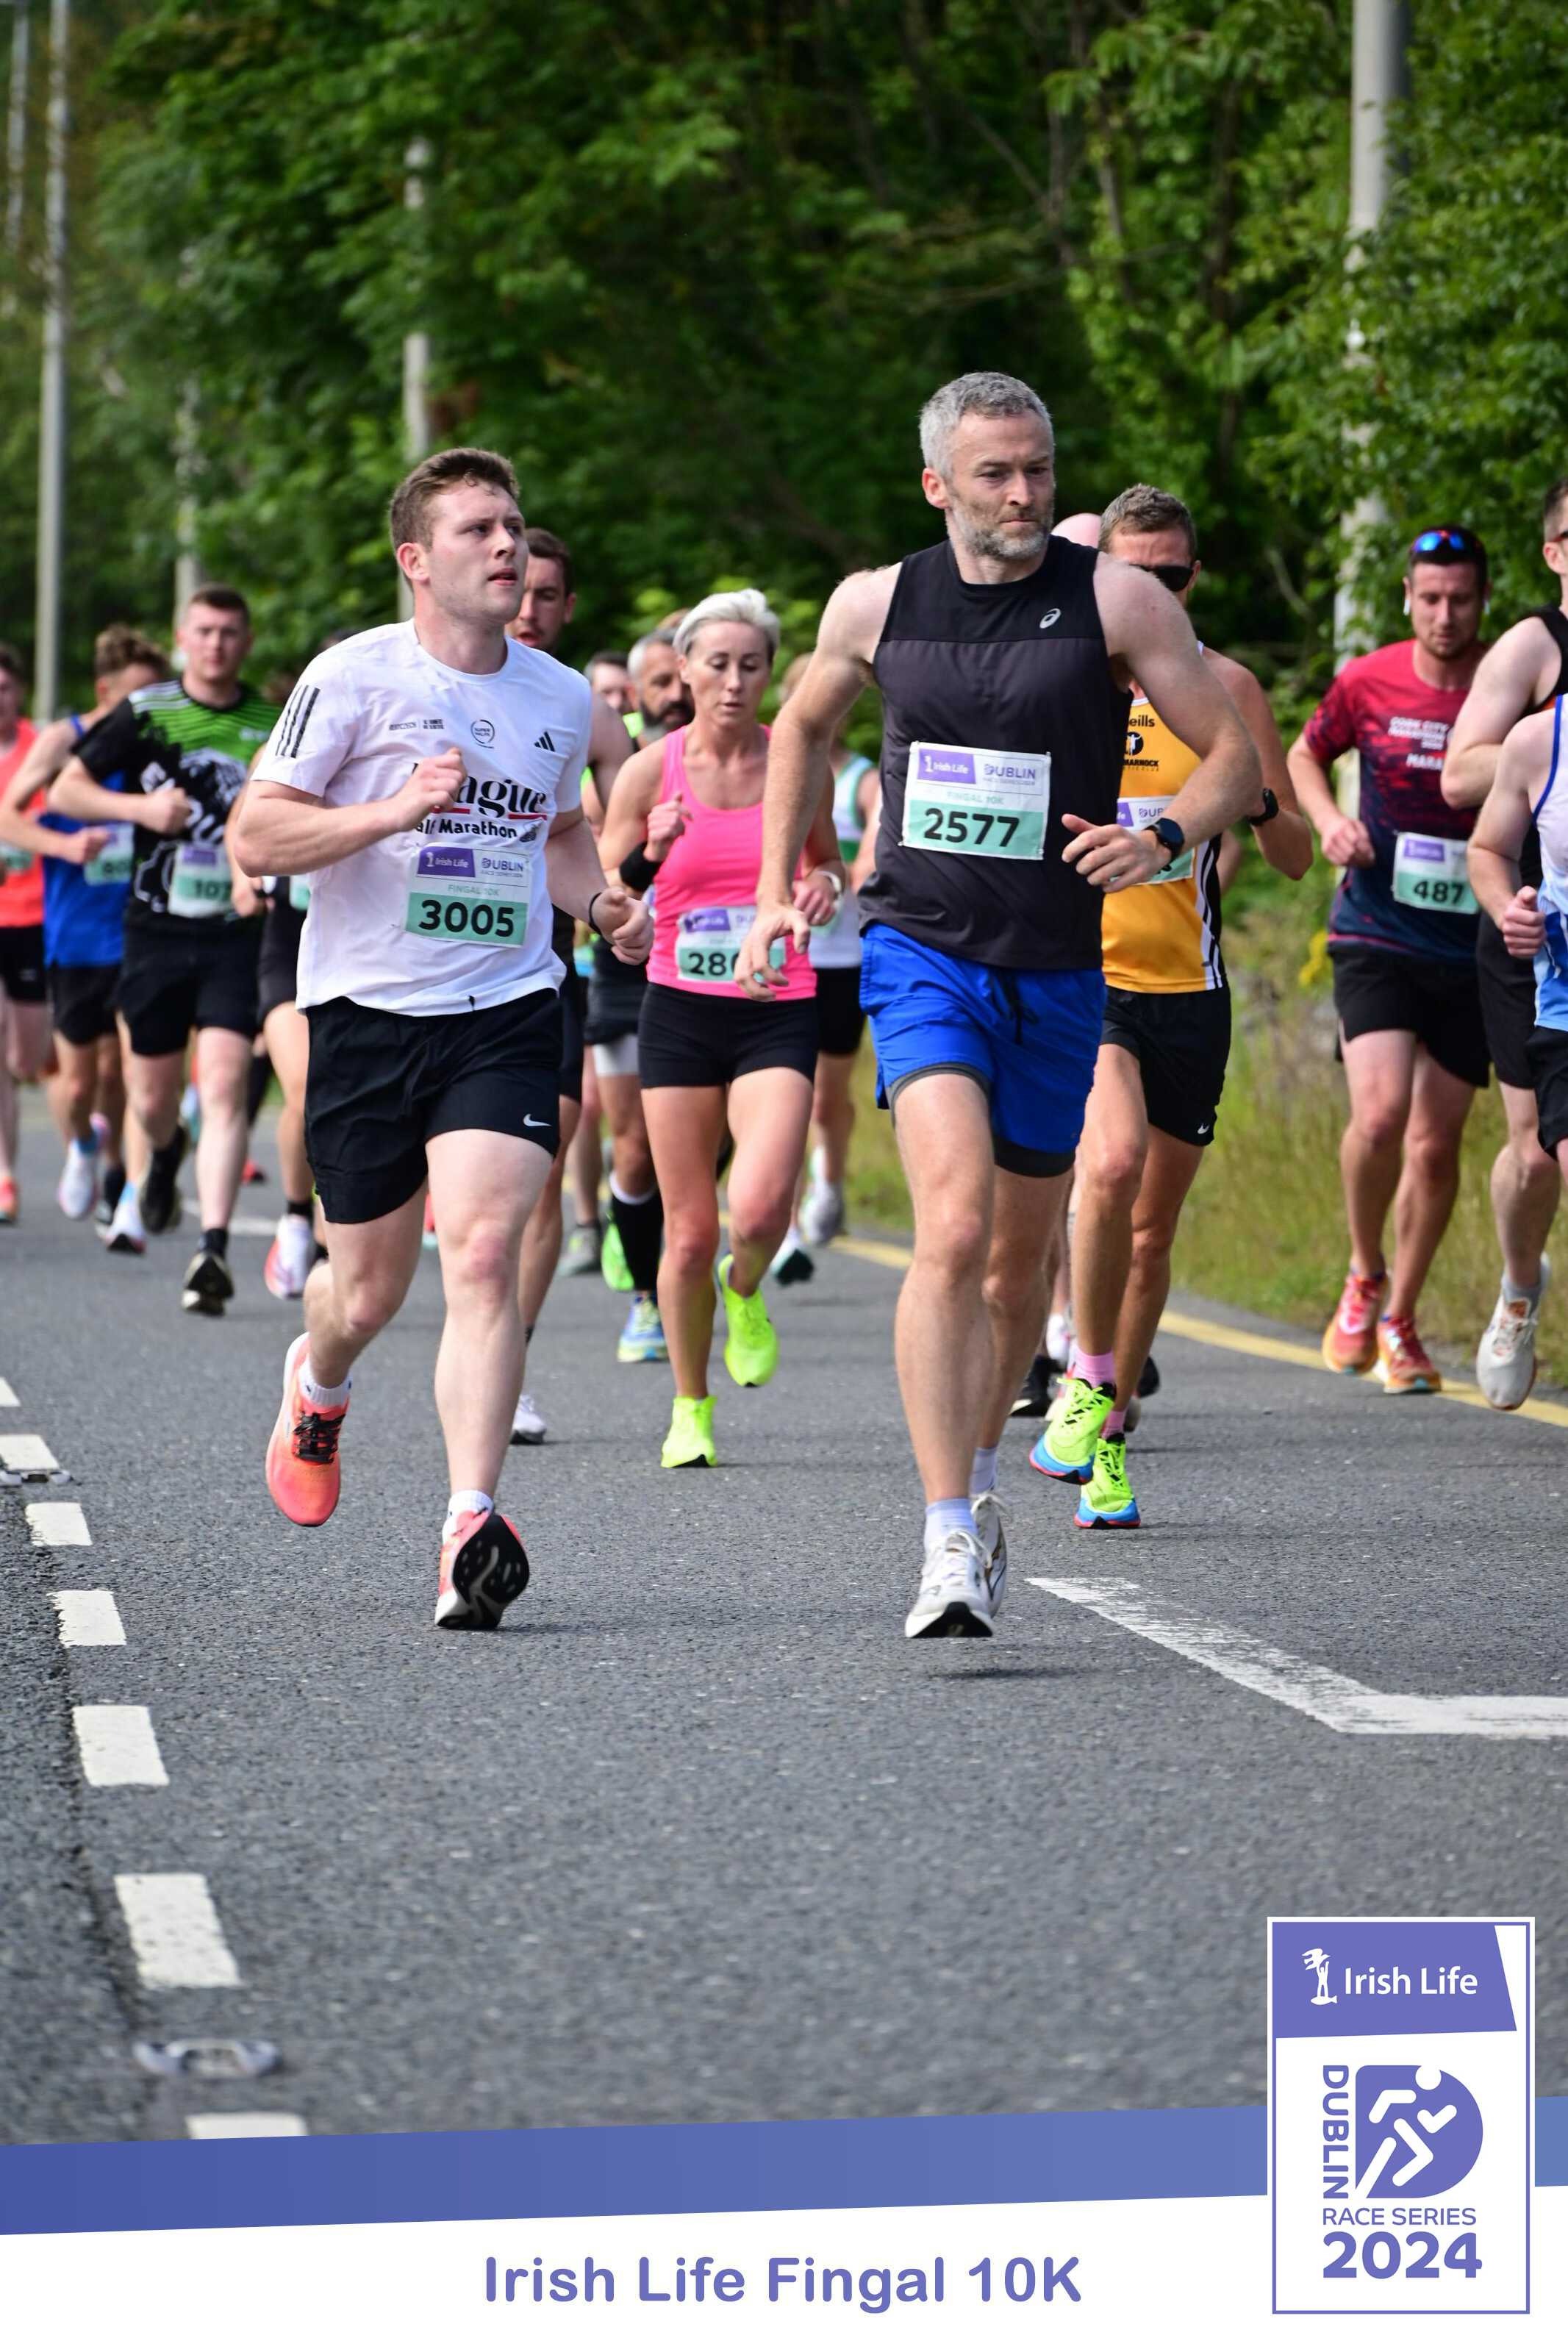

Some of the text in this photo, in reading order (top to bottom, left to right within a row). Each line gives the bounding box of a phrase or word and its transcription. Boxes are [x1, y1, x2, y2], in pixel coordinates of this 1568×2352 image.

[1128, 715, 1155, 727] eills
[934, 760, 969, 774] Irish Life
[417, 818, 518, 839] alf Marathon
[923, 808, 1020, 847] 2577
[435, 858, 470, 868] Irish Life
[1414, 880, 1464, 904] 487
[418, 899, 515, 937] 3005
